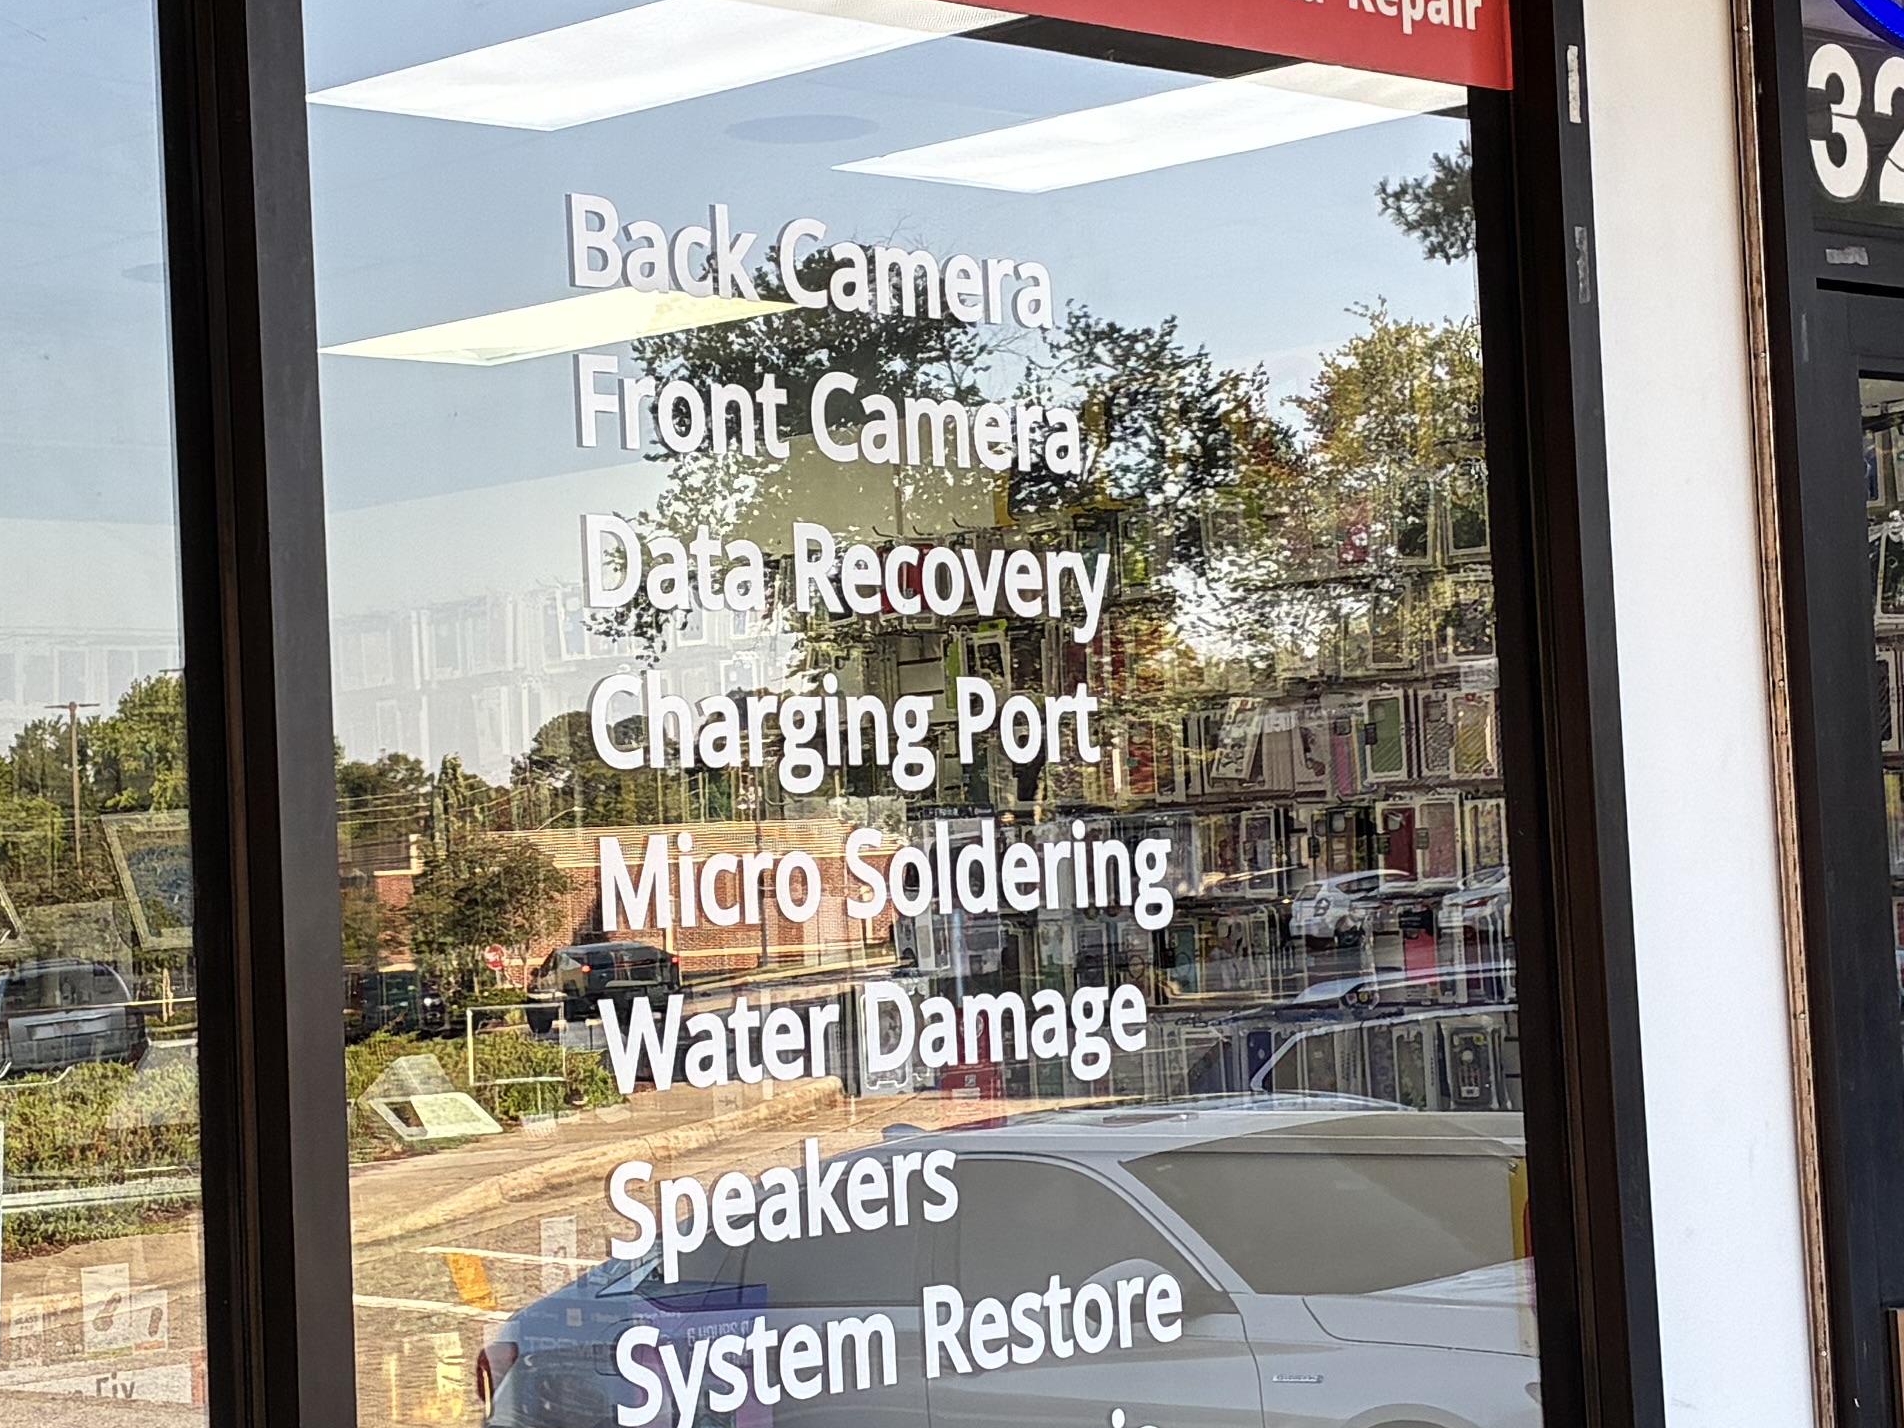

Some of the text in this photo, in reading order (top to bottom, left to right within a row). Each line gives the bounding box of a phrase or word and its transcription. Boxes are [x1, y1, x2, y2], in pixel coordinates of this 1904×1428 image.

[566, 192, 1053, 330] Back Camera
[574, 353, 1082, 474] Front Camera
[582, 513, 1111, 645] Data Recovery
[590, 672, 1102, 794] Charging Port
[599, 818, 1174, 933] Micro Soldering
[599, 979, 1148, 1095] Water Damage
[608, 1138, 960, 1284] Speakers
[924, 1273, 1184, 1380] Restore
